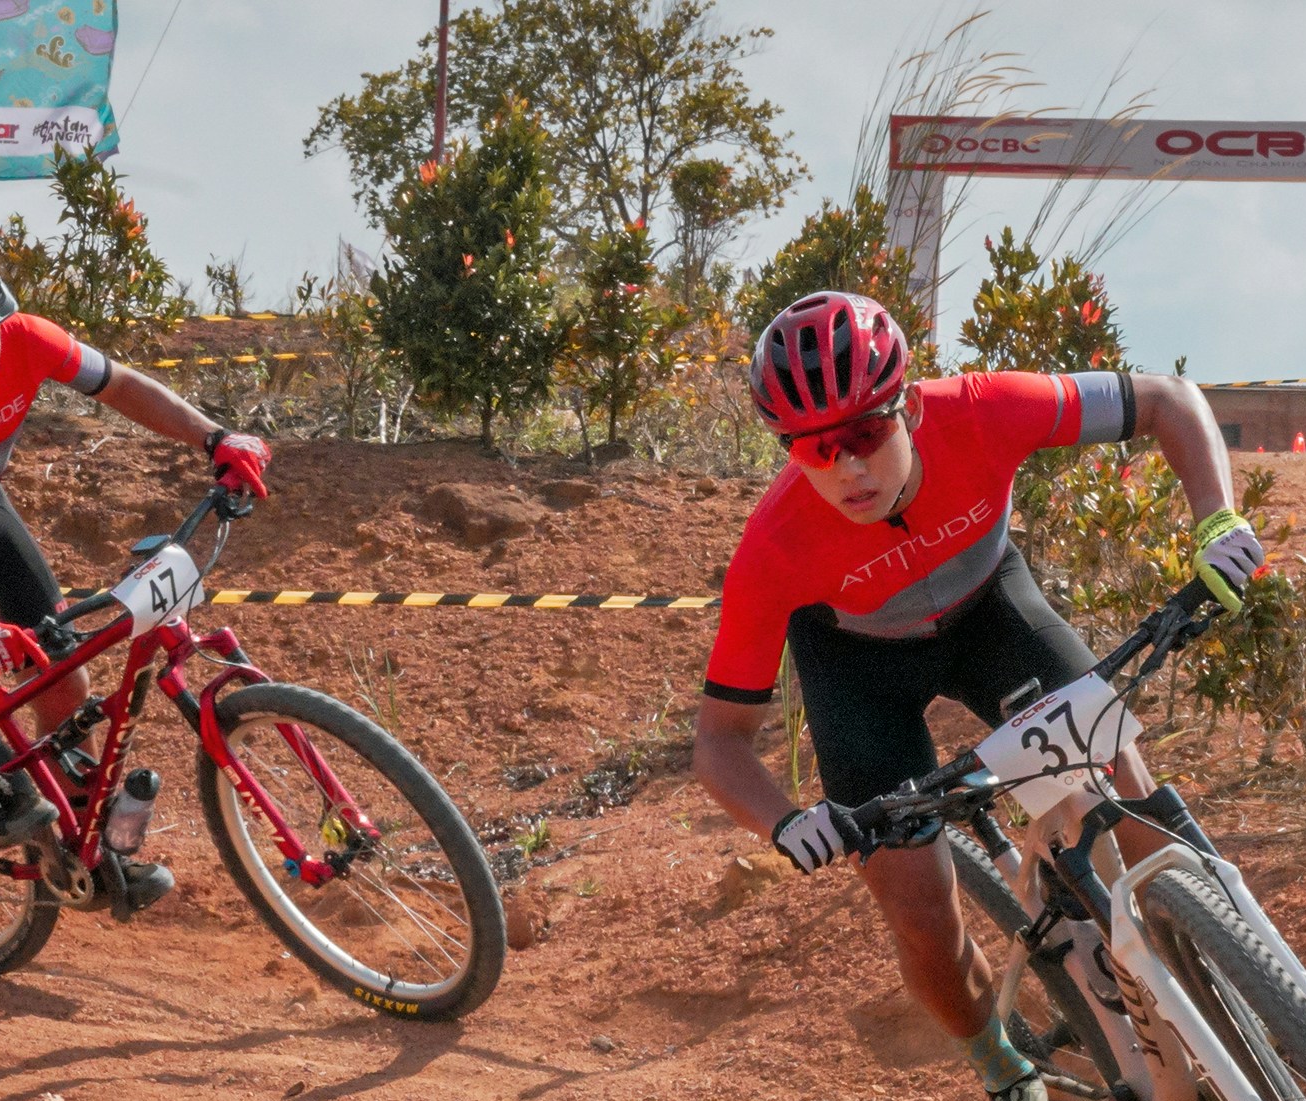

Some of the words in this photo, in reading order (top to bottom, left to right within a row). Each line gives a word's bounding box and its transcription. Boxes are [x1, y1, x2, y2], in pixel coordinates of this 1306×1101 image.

[955, 138, 1041, 154] OCBC
[1153, 159, 1229, 168] NAIONAL
[840, 497, 994, 593] ATTITUDE
[149, 567, 178, 613] 47
[1010, 693, 1058, 728] OCBC
[1020, 699, 1089, 775] 37
[353, 986, 420, 1015] MAXXIS
